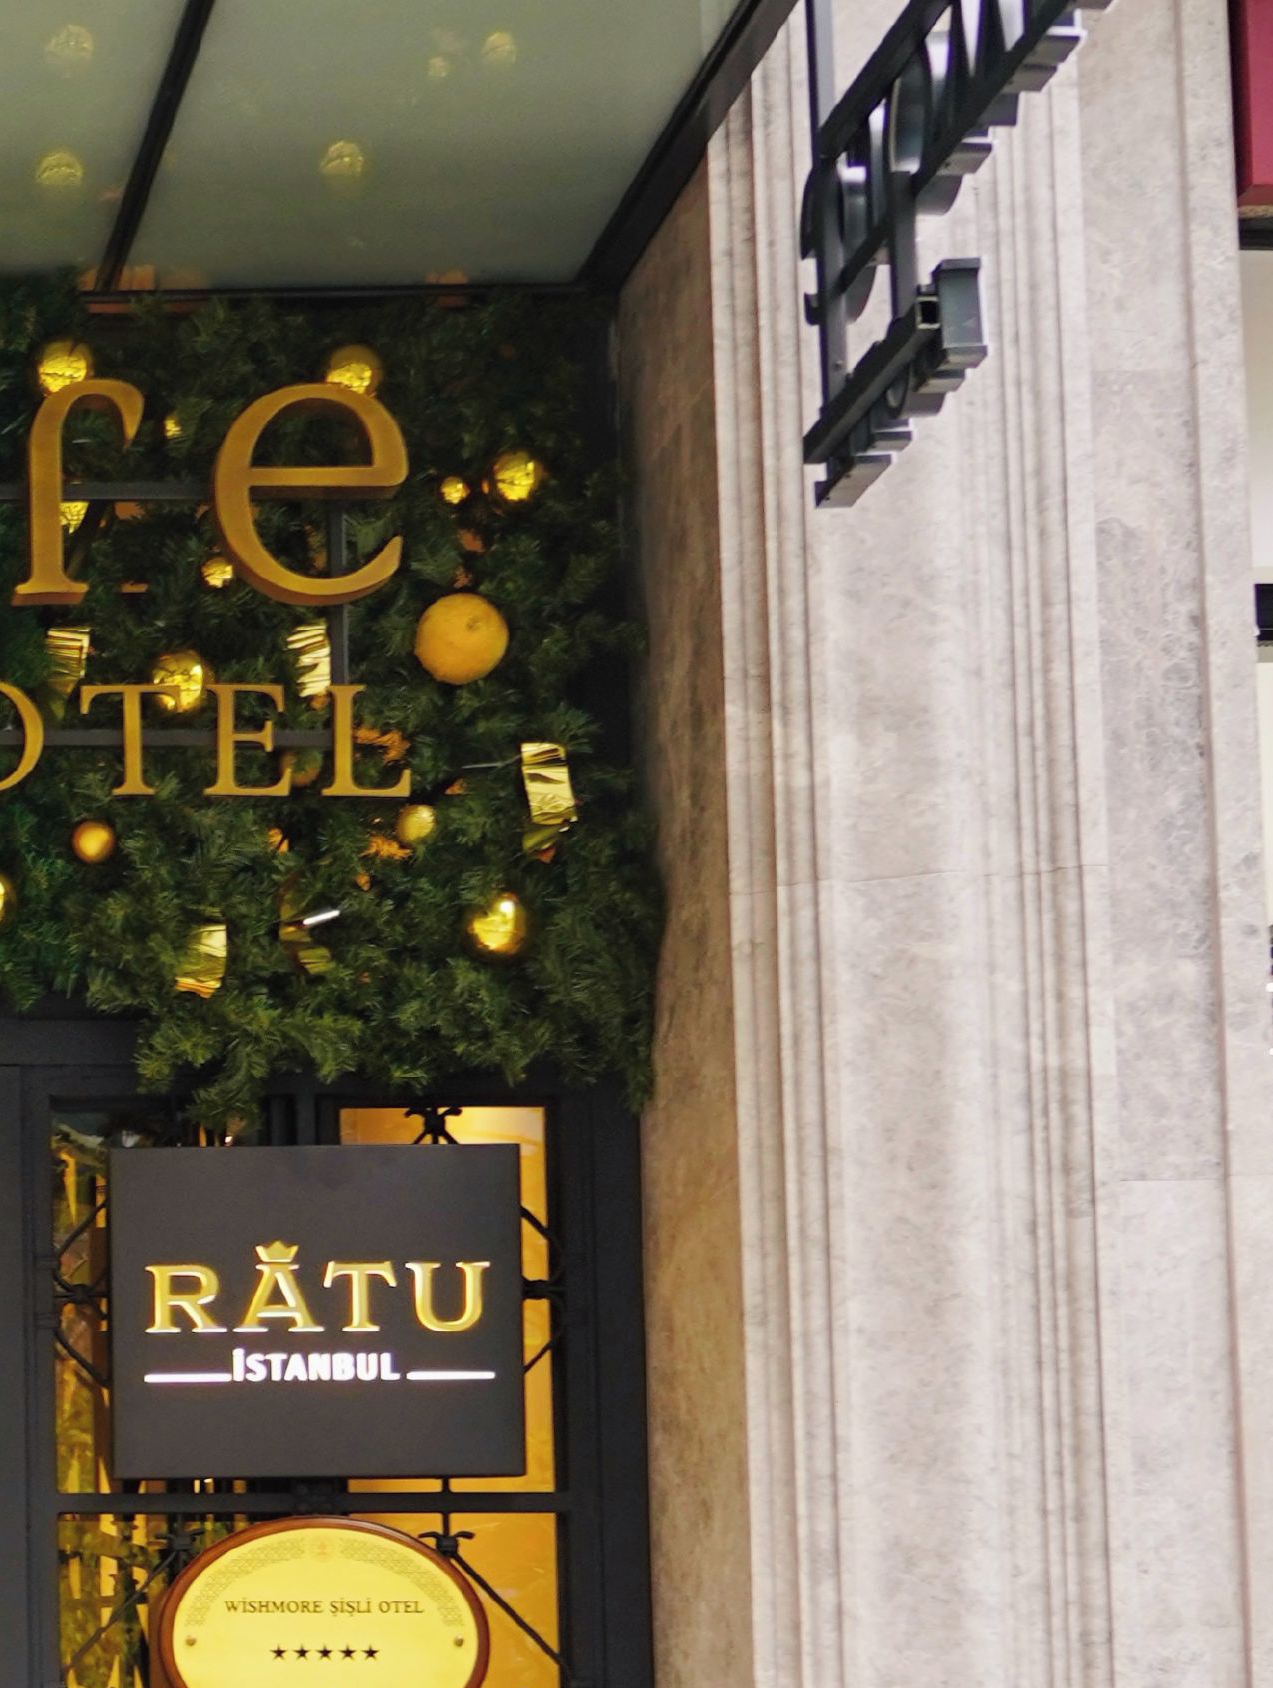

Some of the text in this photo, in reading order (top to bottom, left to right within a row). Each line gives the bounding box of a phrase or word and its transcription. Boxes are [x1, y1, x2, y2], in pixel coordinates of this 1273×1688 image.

[231, 1347, 401, 1383] İSTANBUL
[224, 1596, 424, 1617] WİSHMORE ŞİŞLİ OTEL
